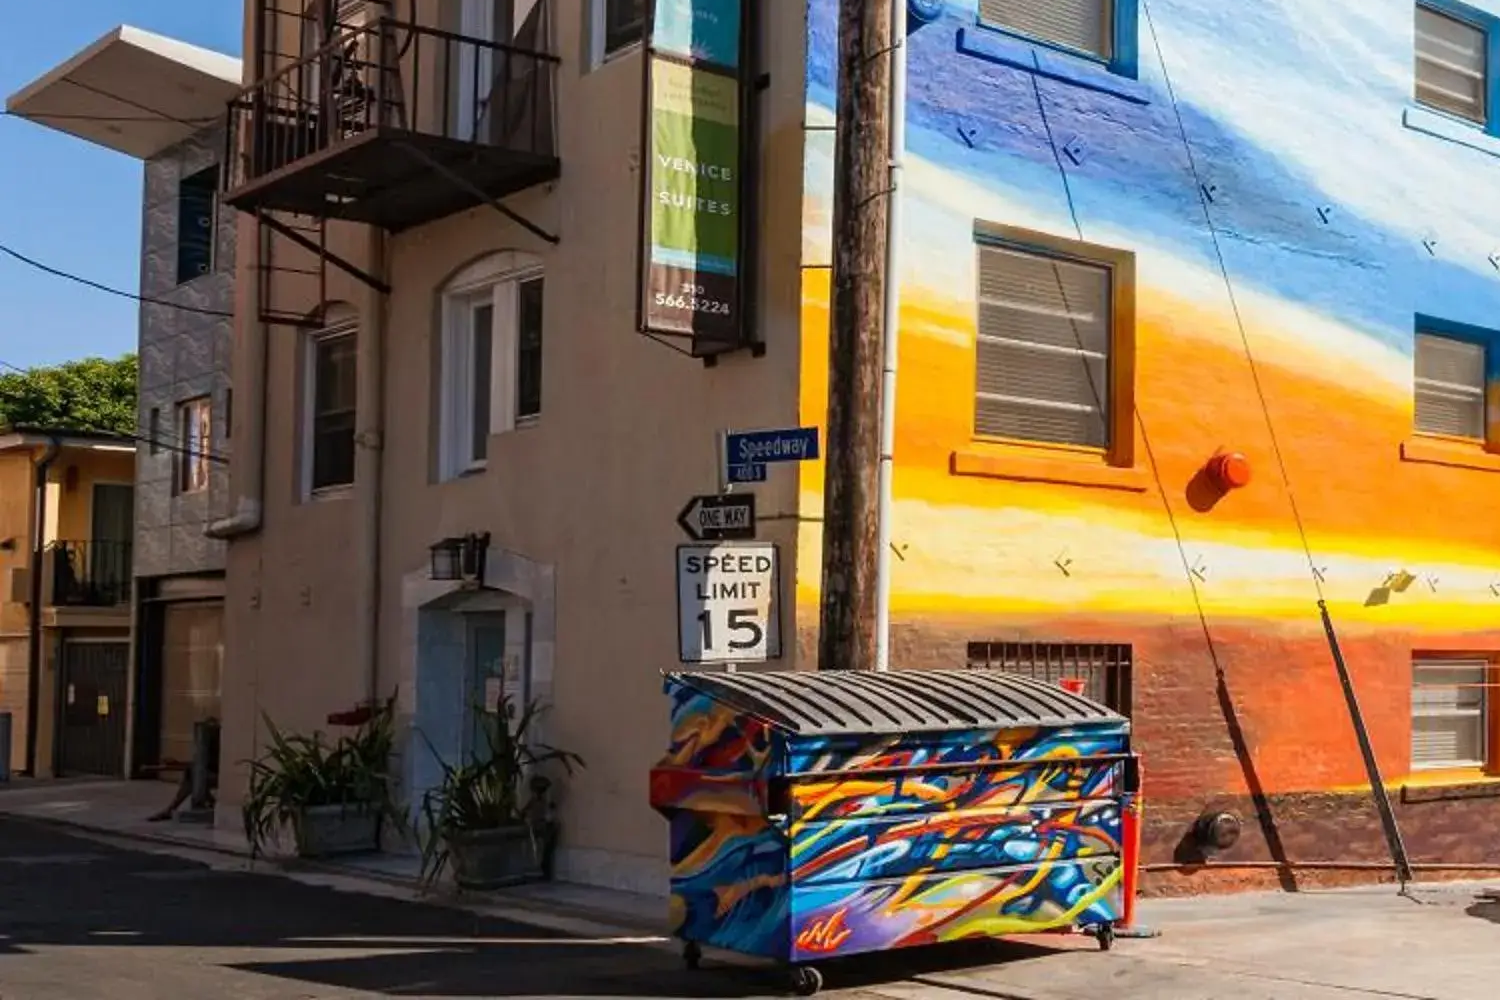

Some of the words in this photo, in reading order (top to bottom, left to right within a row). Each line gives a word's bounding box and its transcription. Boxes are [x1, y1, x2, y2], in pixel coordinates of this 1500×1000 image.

[658, 154, 732, 181] VENICE
[659, 191, 730, 216] SUITES
[739, 436, 809, 459] Speedway
[700, 508, 720, 528] ONE
[723, 506, 748, 525] WAY
[685, 556, 771, 573] SPEED
[696, 582, 761, 600] LIMIT
[696, 608, 763, 651] 15
